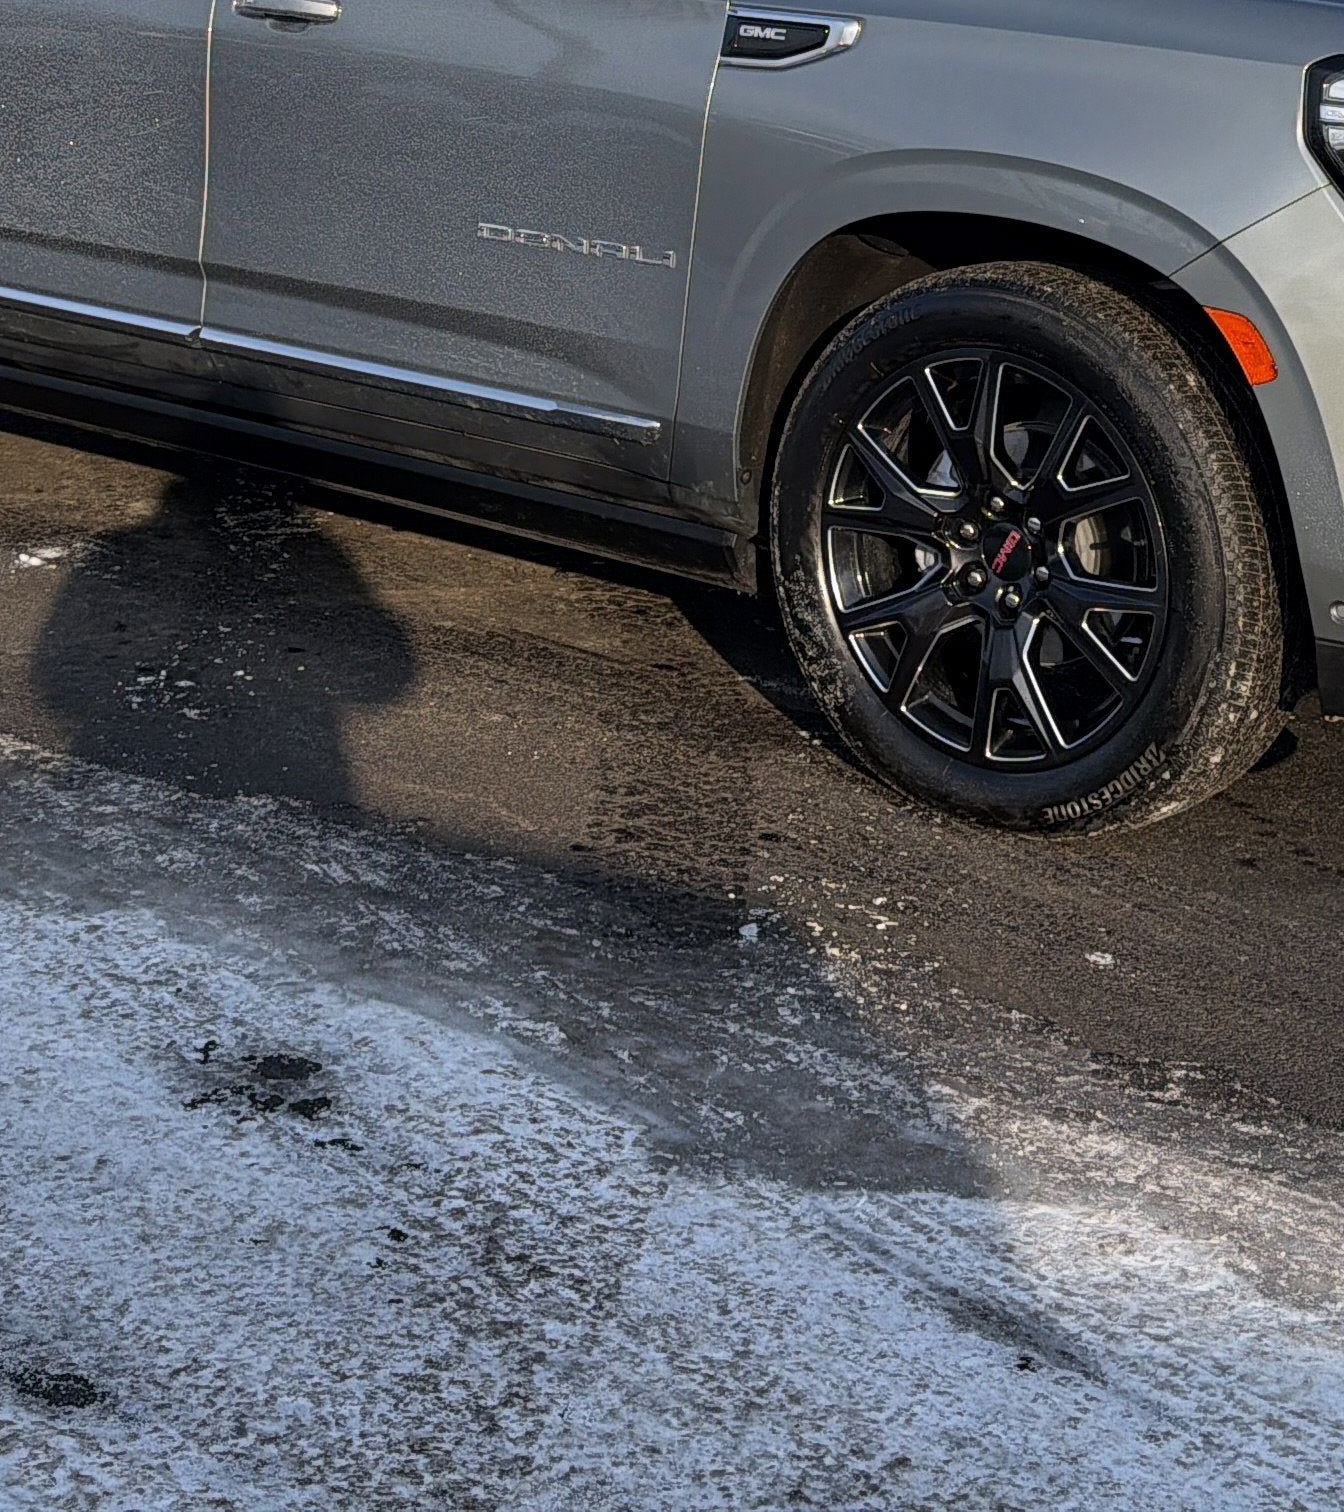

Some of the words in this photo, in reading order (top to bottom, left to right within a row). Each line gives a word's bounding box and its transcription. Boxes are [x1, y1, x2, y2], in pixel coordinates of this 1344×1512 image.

[739, 24, 787, 41] GMC
[477, 222, 676, 269] DENALI
[991, 529, 1021, 574] GMC
[1042, 741, 1167, 825] BRIDGESTONE
